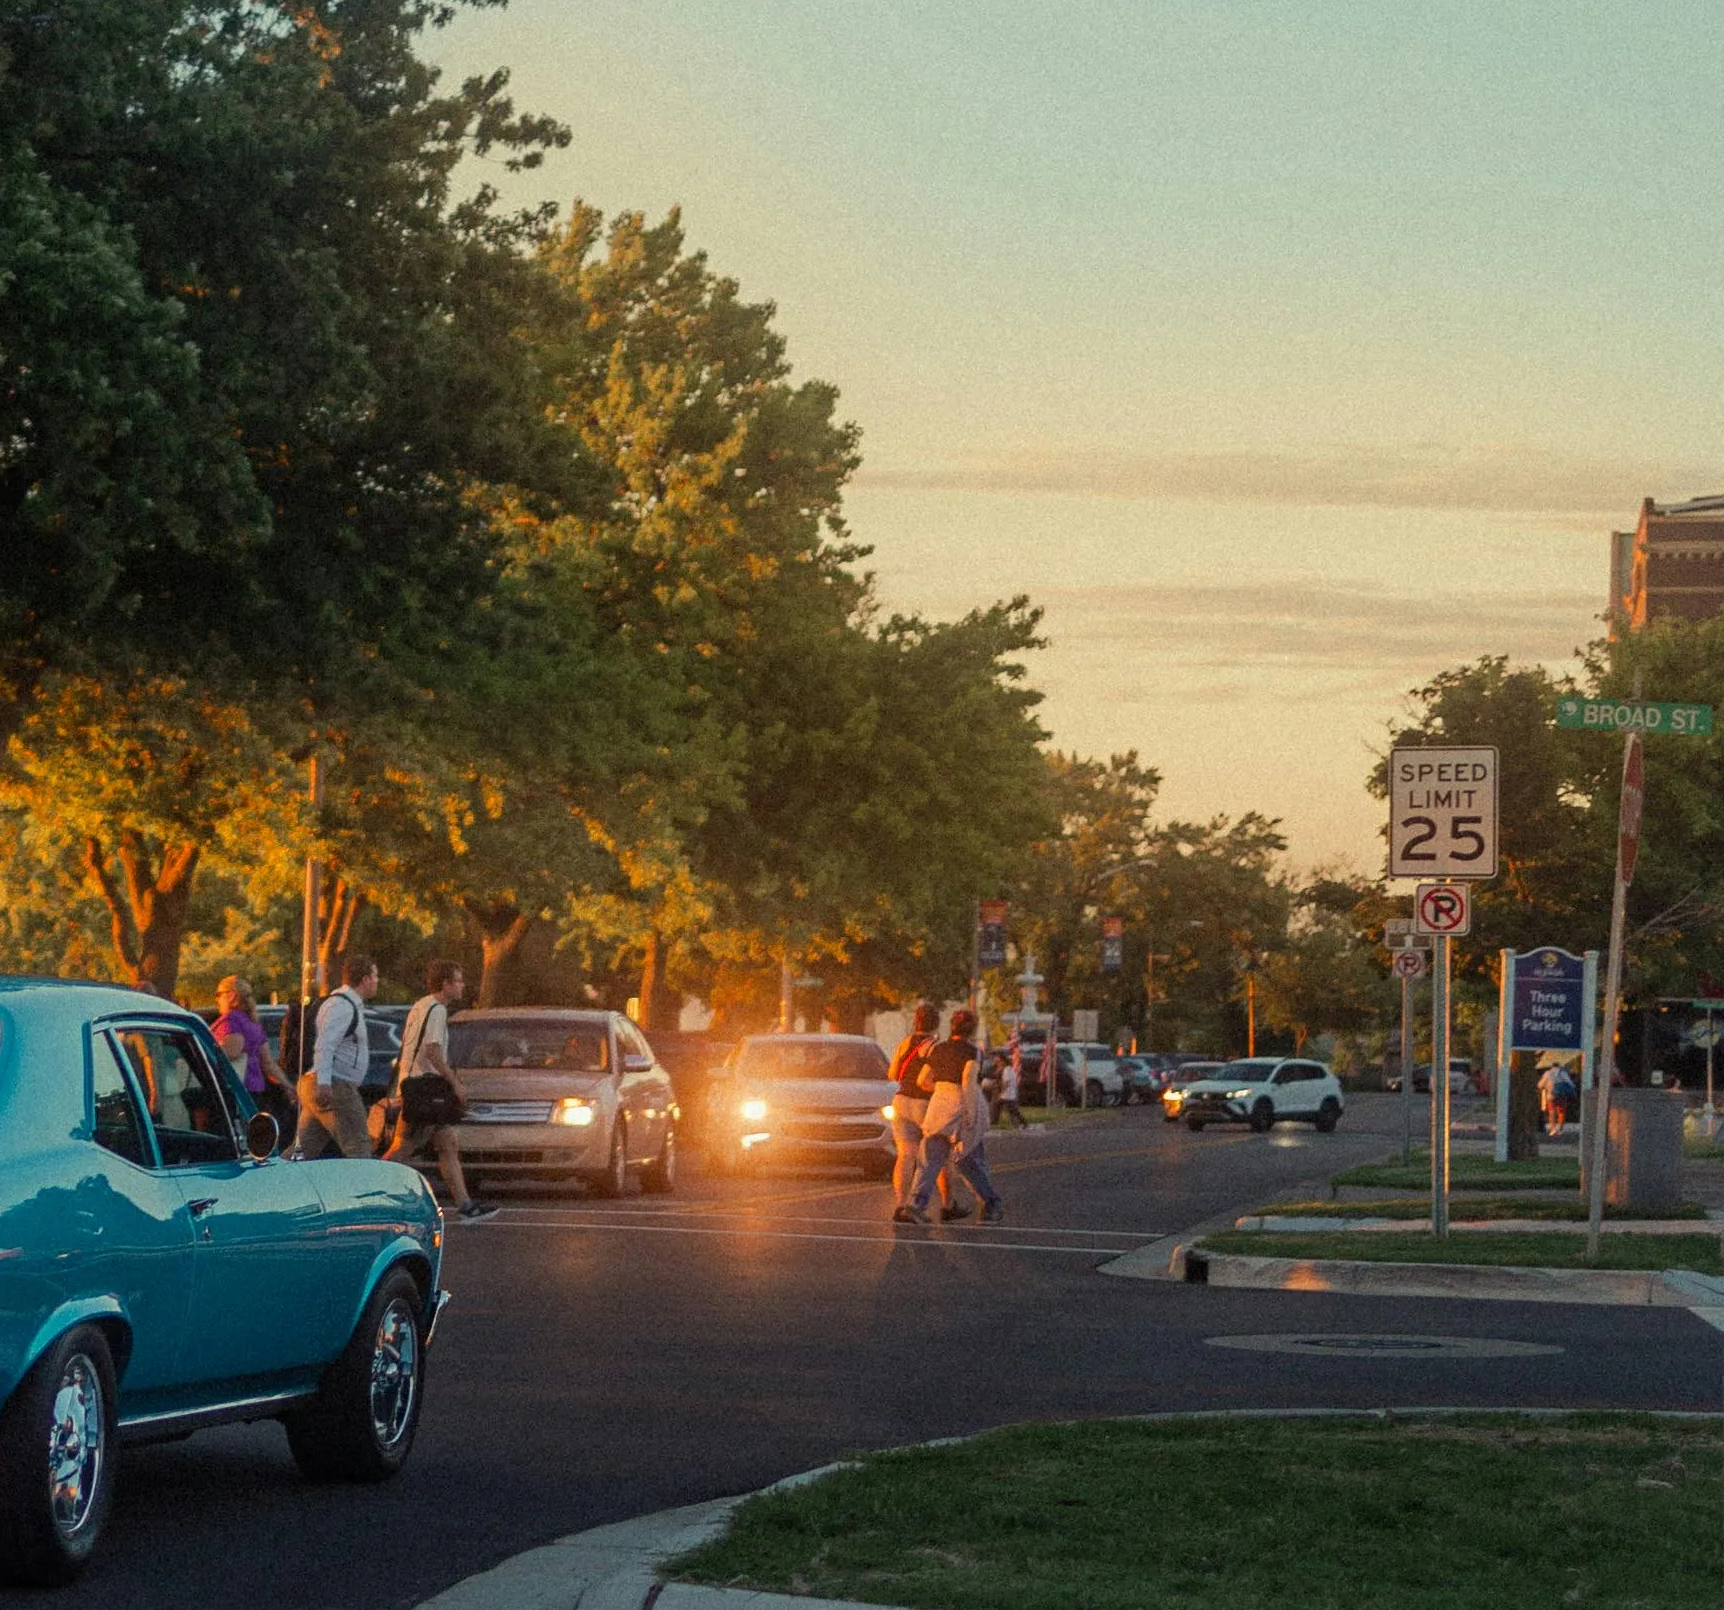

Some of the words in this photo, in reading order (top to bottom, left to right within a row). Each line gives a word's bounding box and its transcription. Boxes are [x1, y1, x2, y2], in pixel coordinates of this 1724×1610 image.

[1583, 703, 1662, 728] BROAD
[1671, 708, 1705, 730] ST.
[1400, 763, 1488, 782] SPEED
[1409, 790, 1477, 809] LIMIT
[1401, 816, 1485, 861] 25
[1432, 895, 1456, 923] P
[1530, 990, 1567, 1004] Three
[1531, 1004, 1565, 1018] Hour
[1523, 1018, 1573, 1036] Parking
